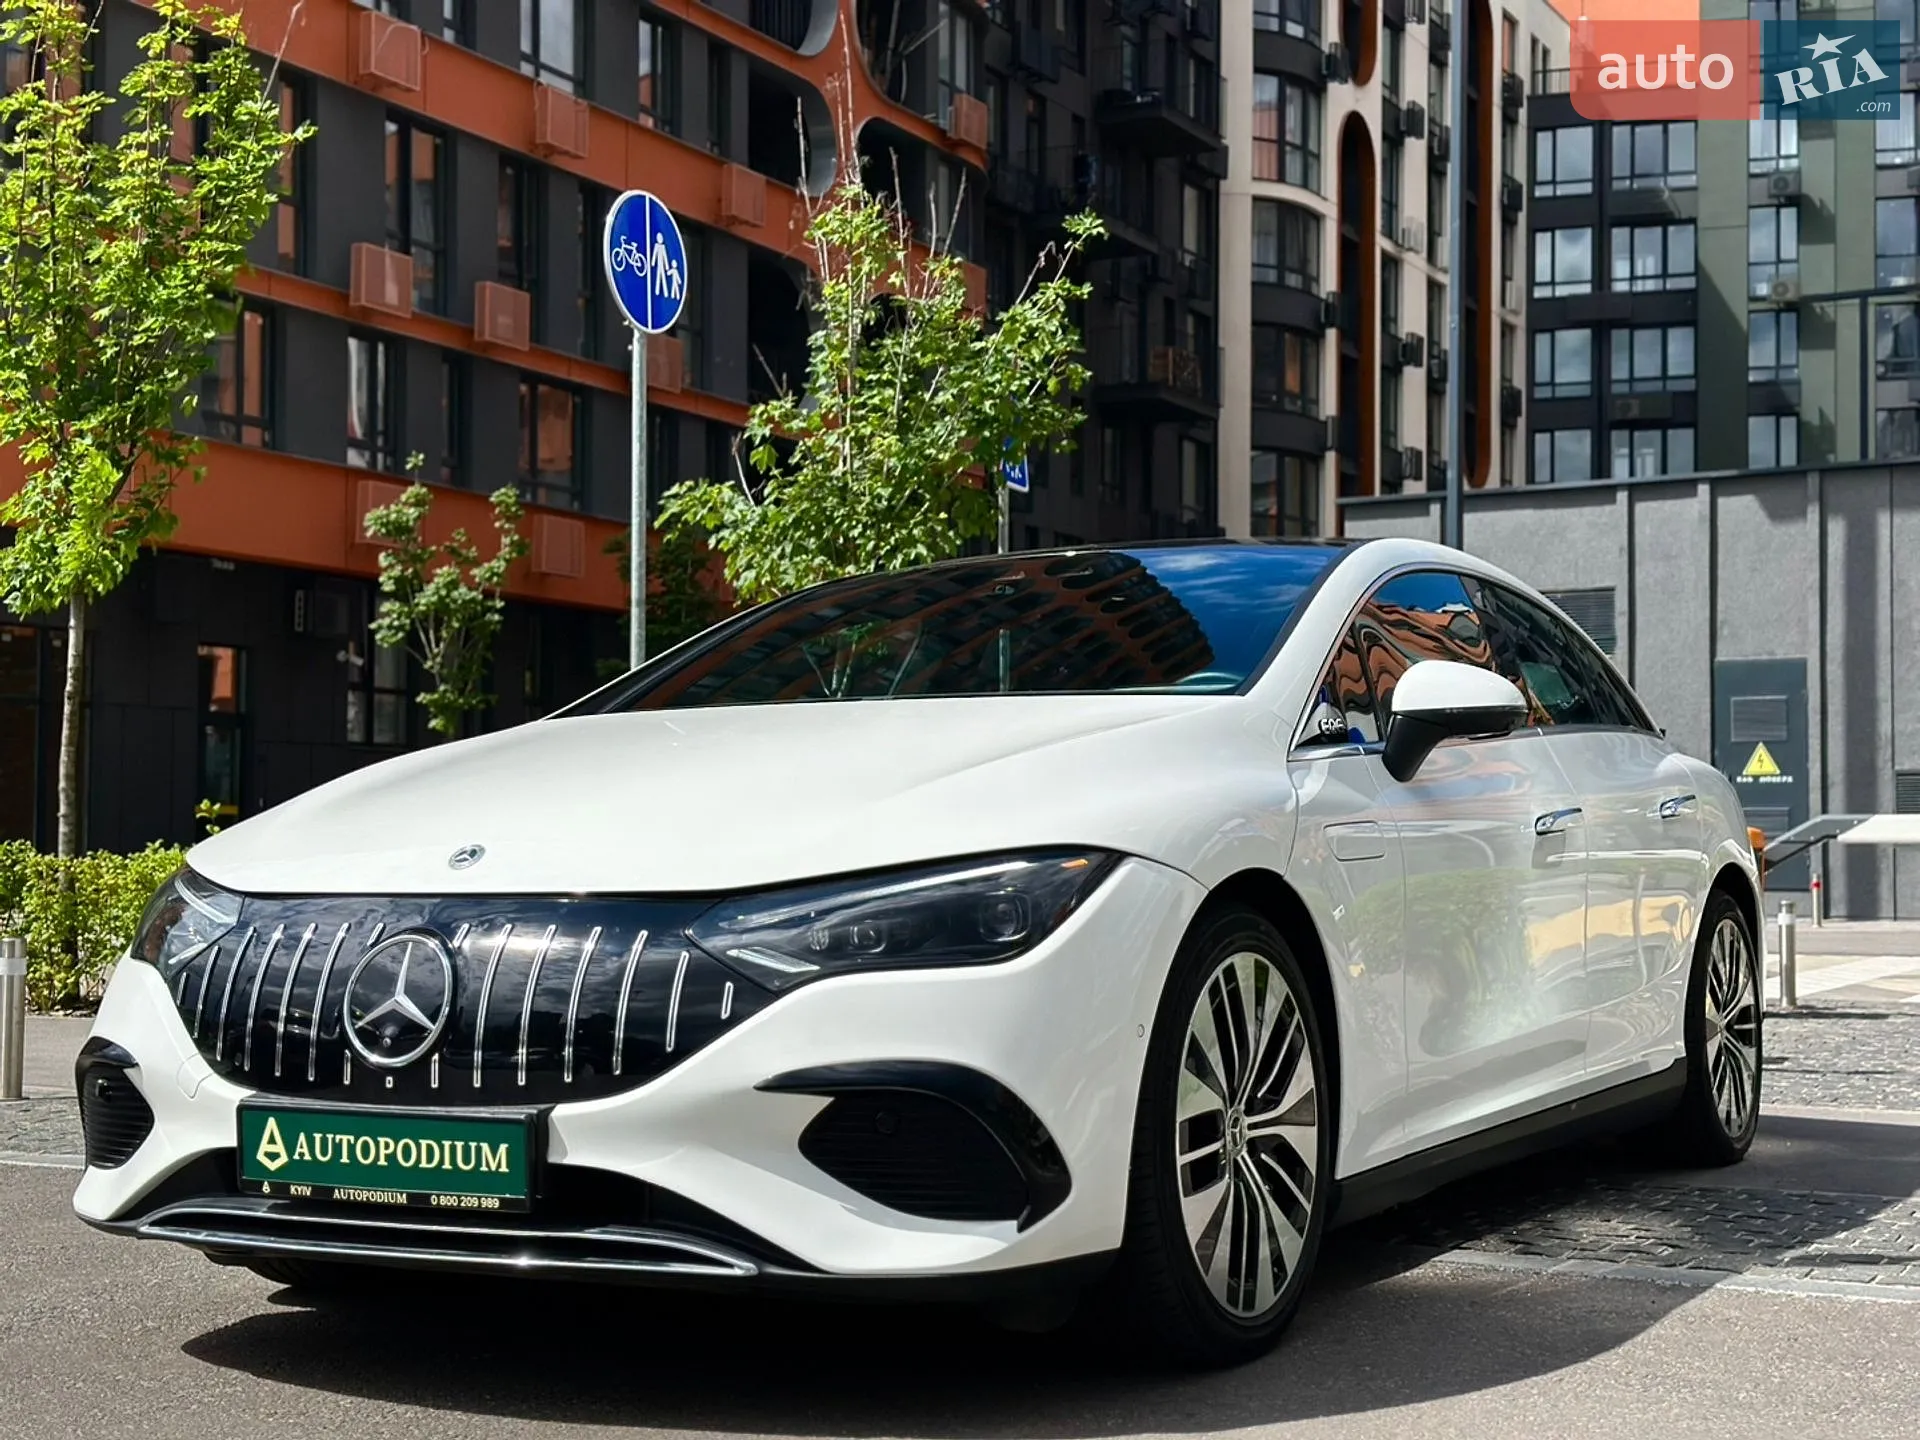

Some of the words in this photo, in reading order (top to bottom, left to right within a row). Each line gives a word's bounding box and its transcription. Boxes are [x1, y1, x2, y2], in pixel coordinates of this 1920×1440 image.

[293, 1131, 510, 1173] AUTOPODIUM
[289, 1184, 312, 1196] KYIV
[333, 1188, 407, 1204] AUTOPODIUM
[439, 1195, 459, 1206] 800
[460, 1196, 479, 1207] 209
[480, 1197, 500, 1208] 989
